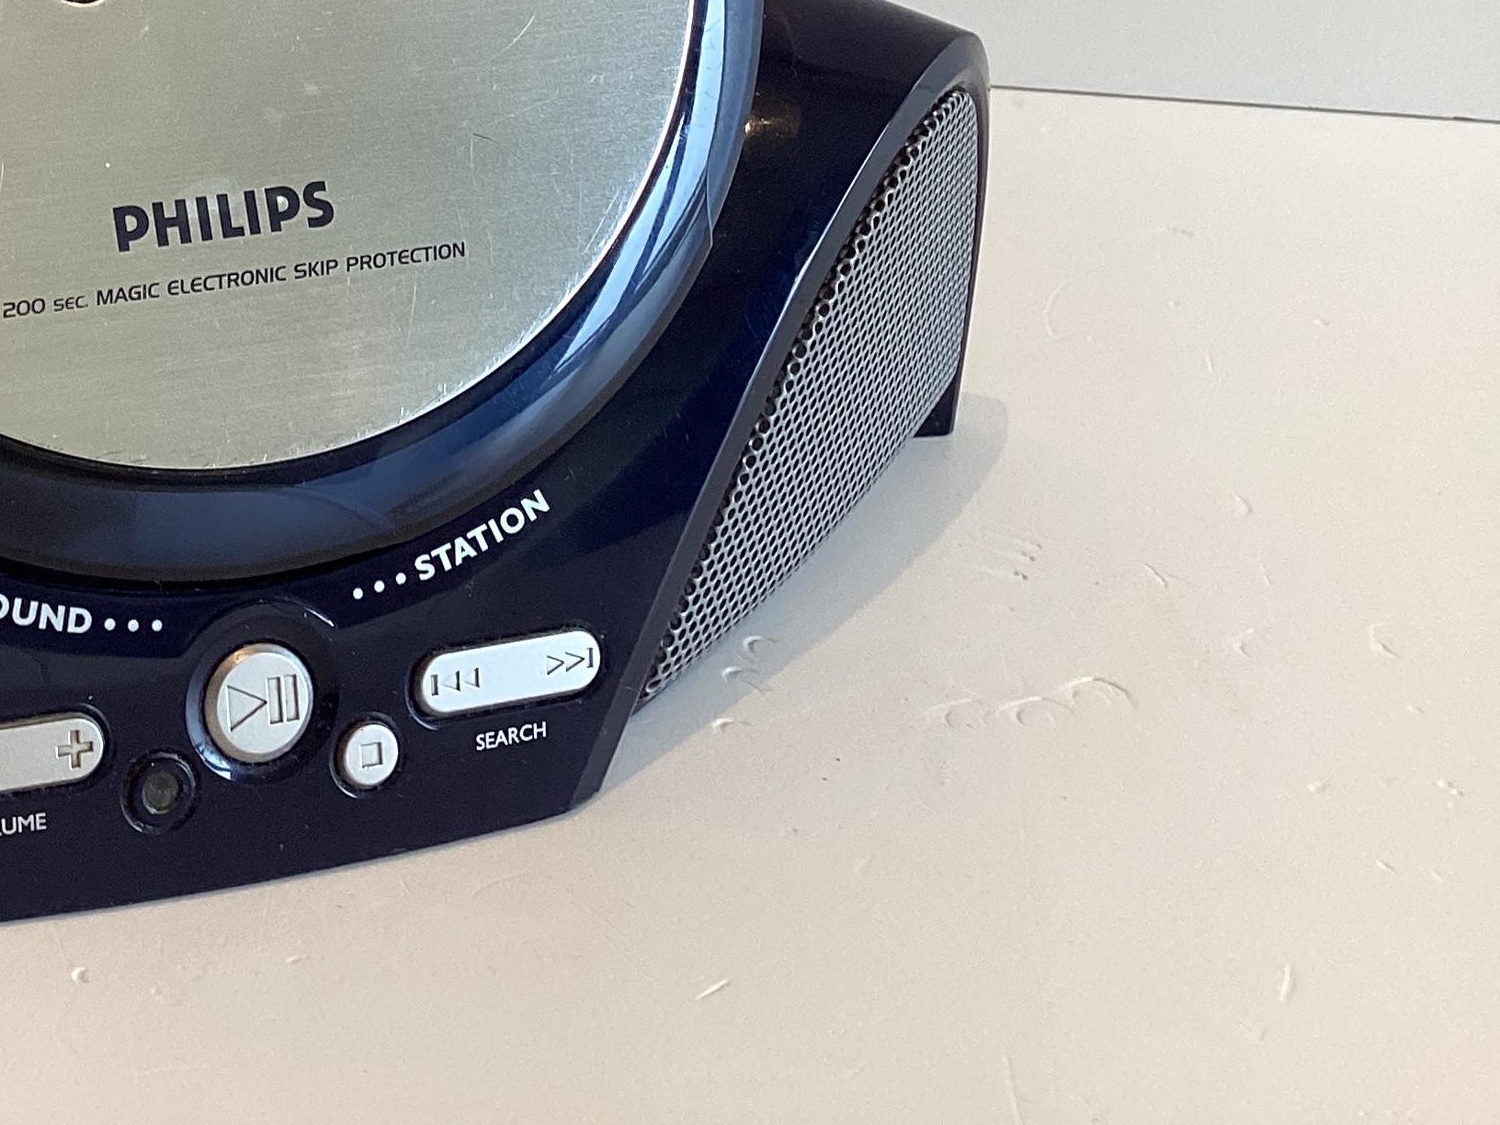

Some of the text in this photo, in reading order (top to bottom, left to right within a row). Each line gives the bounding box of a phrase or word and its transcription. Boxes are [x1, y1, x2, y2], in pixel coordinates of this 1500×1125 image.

[112, 180, 335, 252] PHILIPS
[2, 297, 46, 319] 200
[96, 281, 161, 307] MAGIC
[167, 264, 287, 297] ELECTRONIC
[293, 258, 340, 280] SKIP
[346, 241, 467, 273] PROTECTION
[413, 488, 552, 583] STATION
[475, 721, 548, 752] SEARCH
